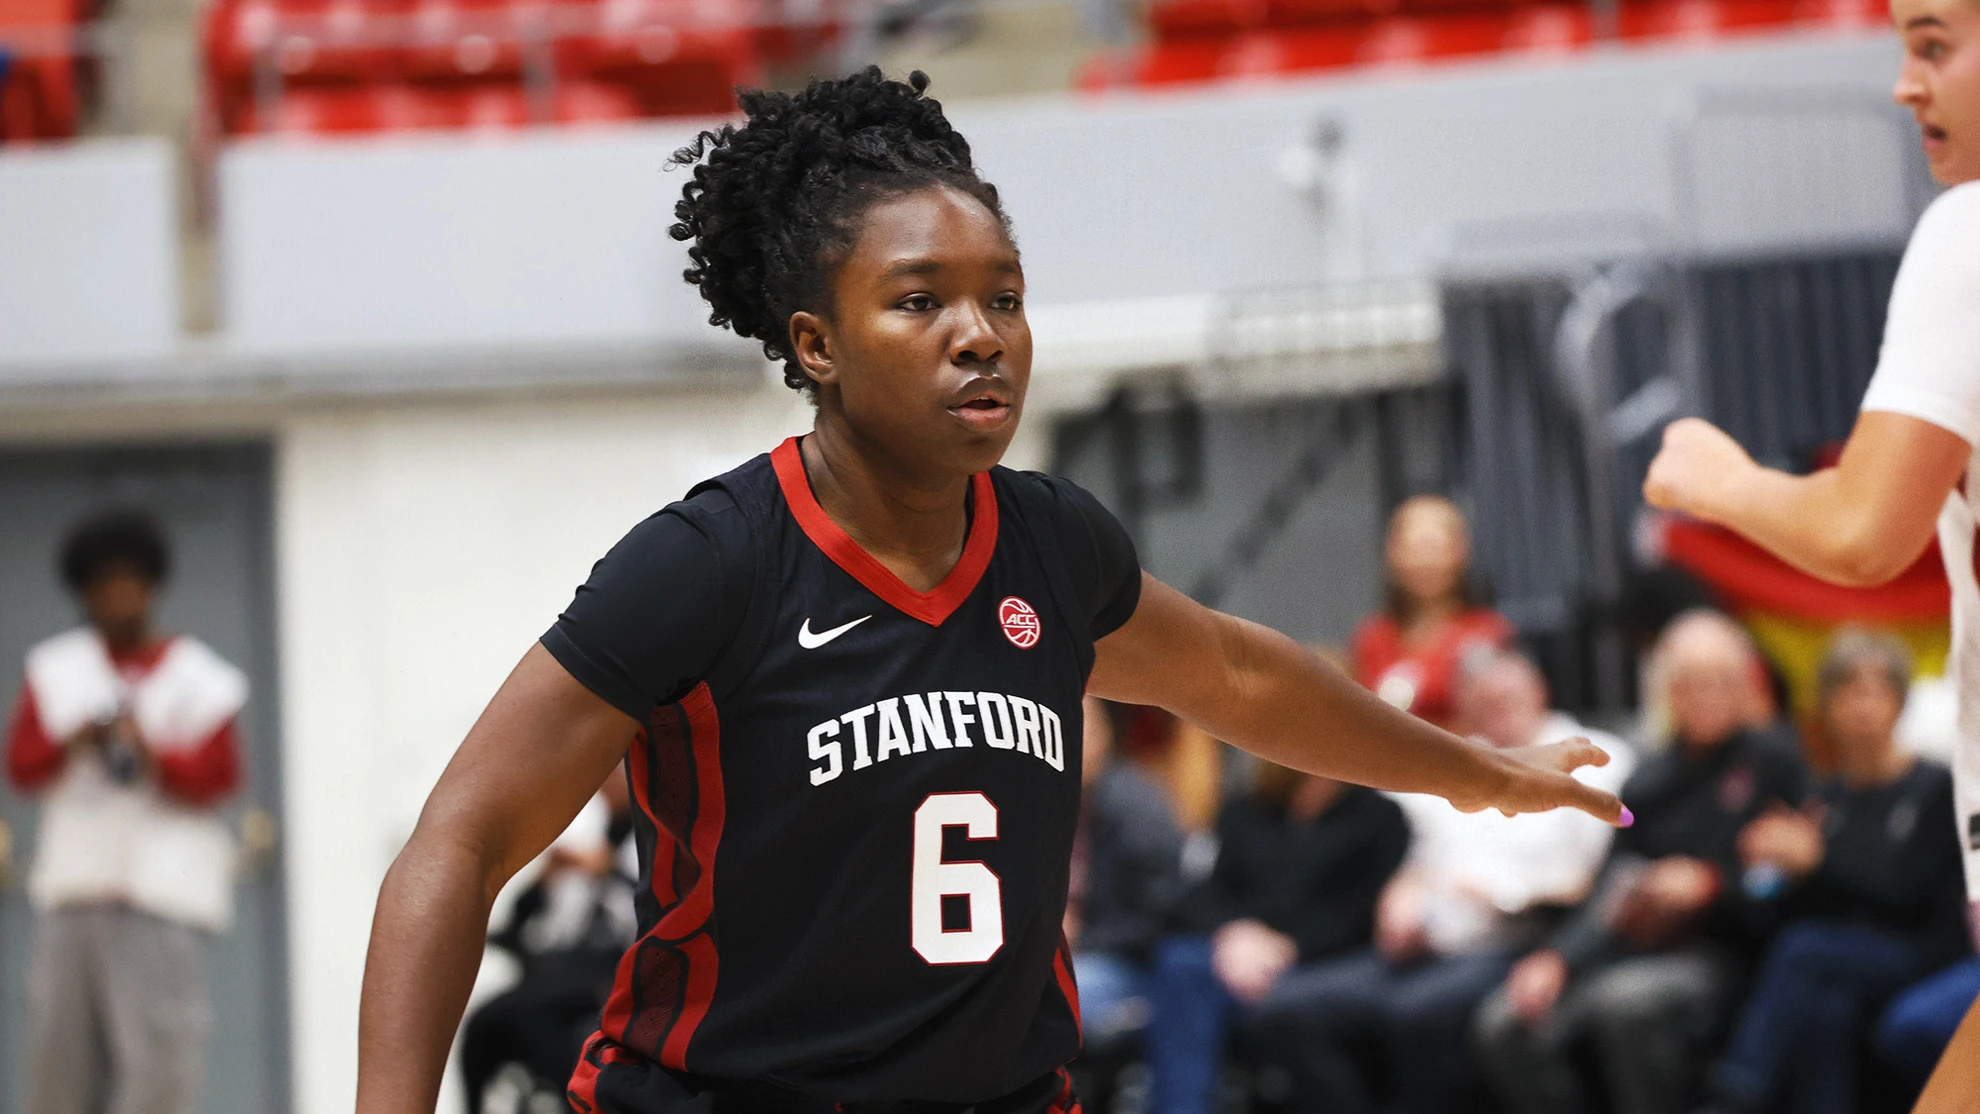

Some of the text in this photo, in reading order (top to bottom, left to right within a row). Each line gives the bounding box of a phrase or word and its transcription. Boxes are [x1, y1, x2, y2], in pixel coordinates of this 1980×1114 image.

[1006, 613, 1036, 625] ACC
[807, 691, 1064, 786] STANFORD
[911, 790, 1004, 966] 6
